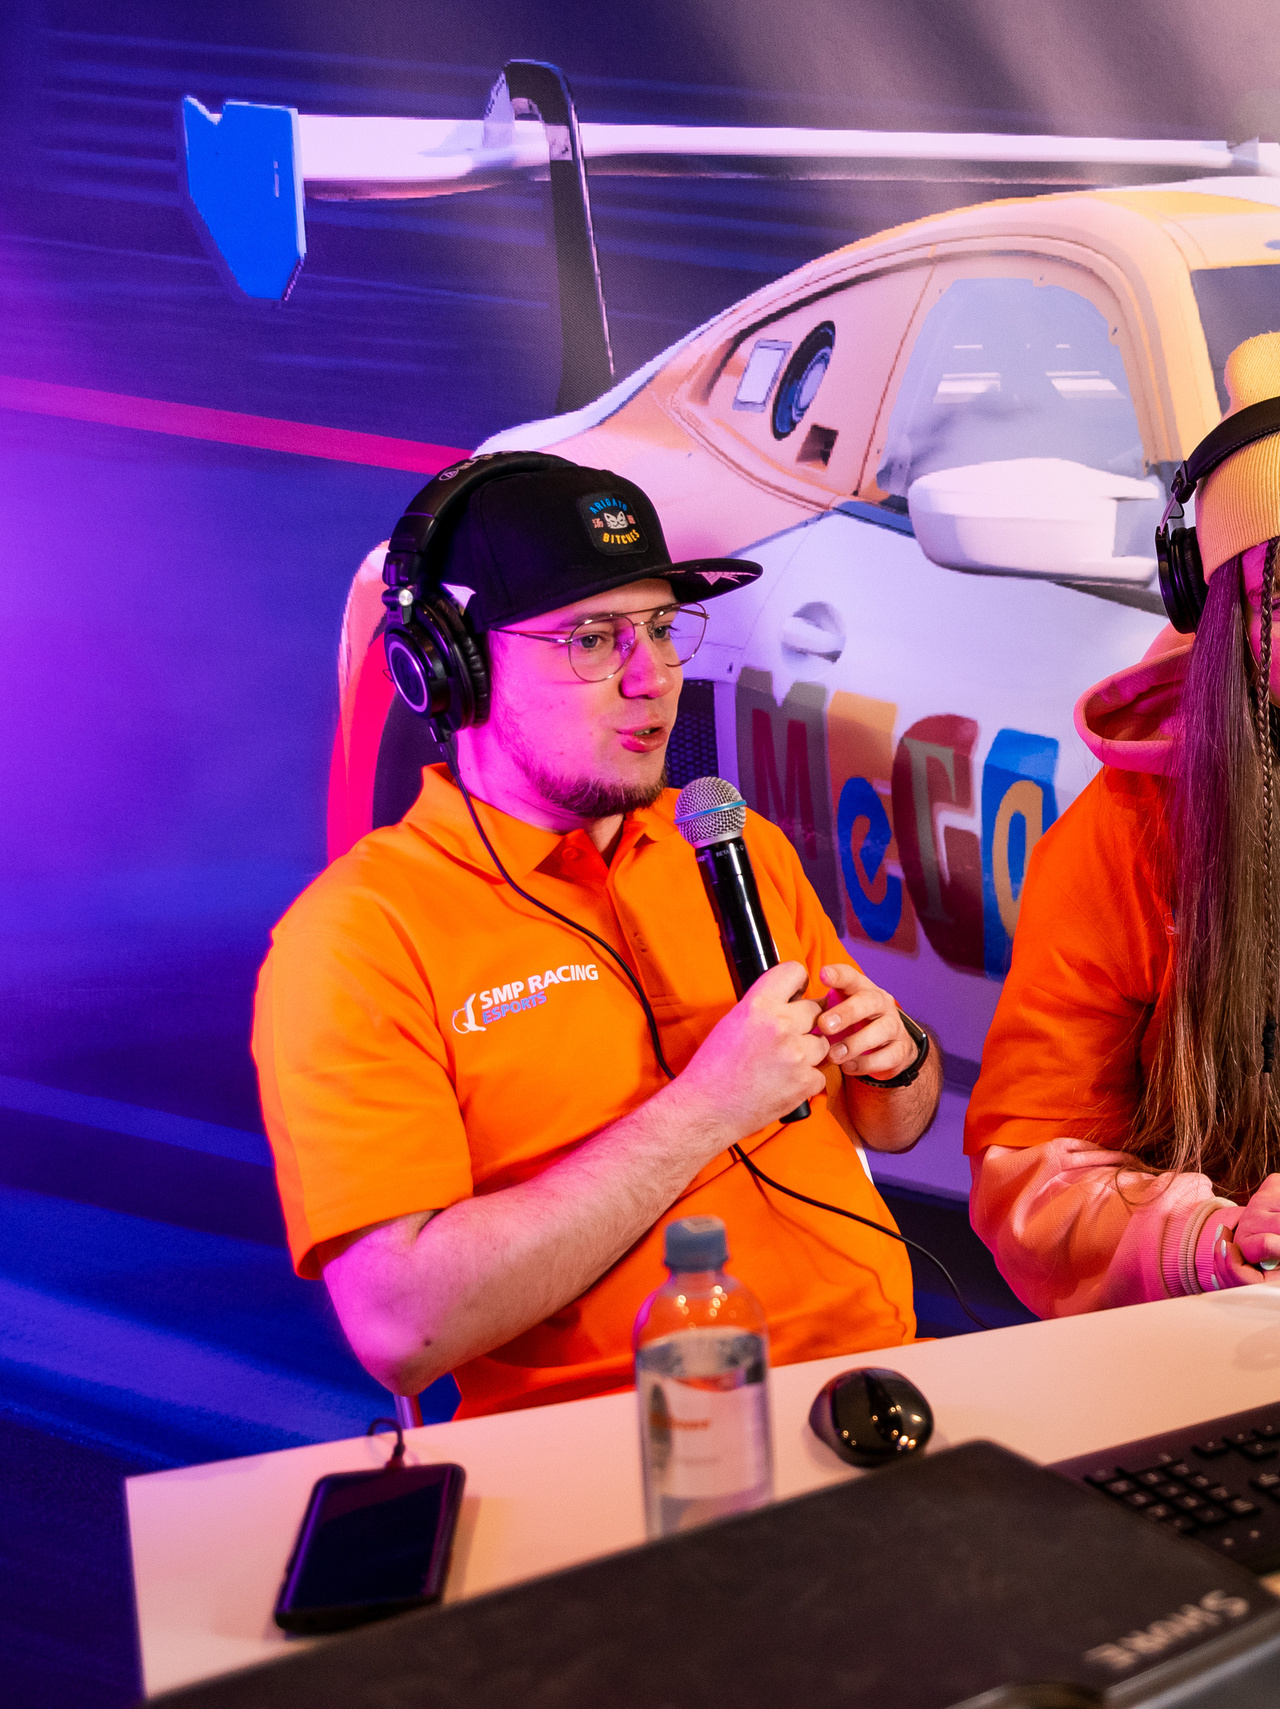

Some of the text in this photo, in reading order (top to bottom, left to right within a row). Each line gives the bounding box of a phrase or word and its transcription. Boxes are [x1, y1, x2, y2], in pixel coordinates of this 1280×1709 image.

[589, 498, 627, 514] ARIGATO
[603, 528, 640, 545] BITCHES
[479, 964, 599, 1009] SMP RACING
[481, 991, 547, 1024] ESPORTS
[1085, 1590, 1249, 1669] SHURE
